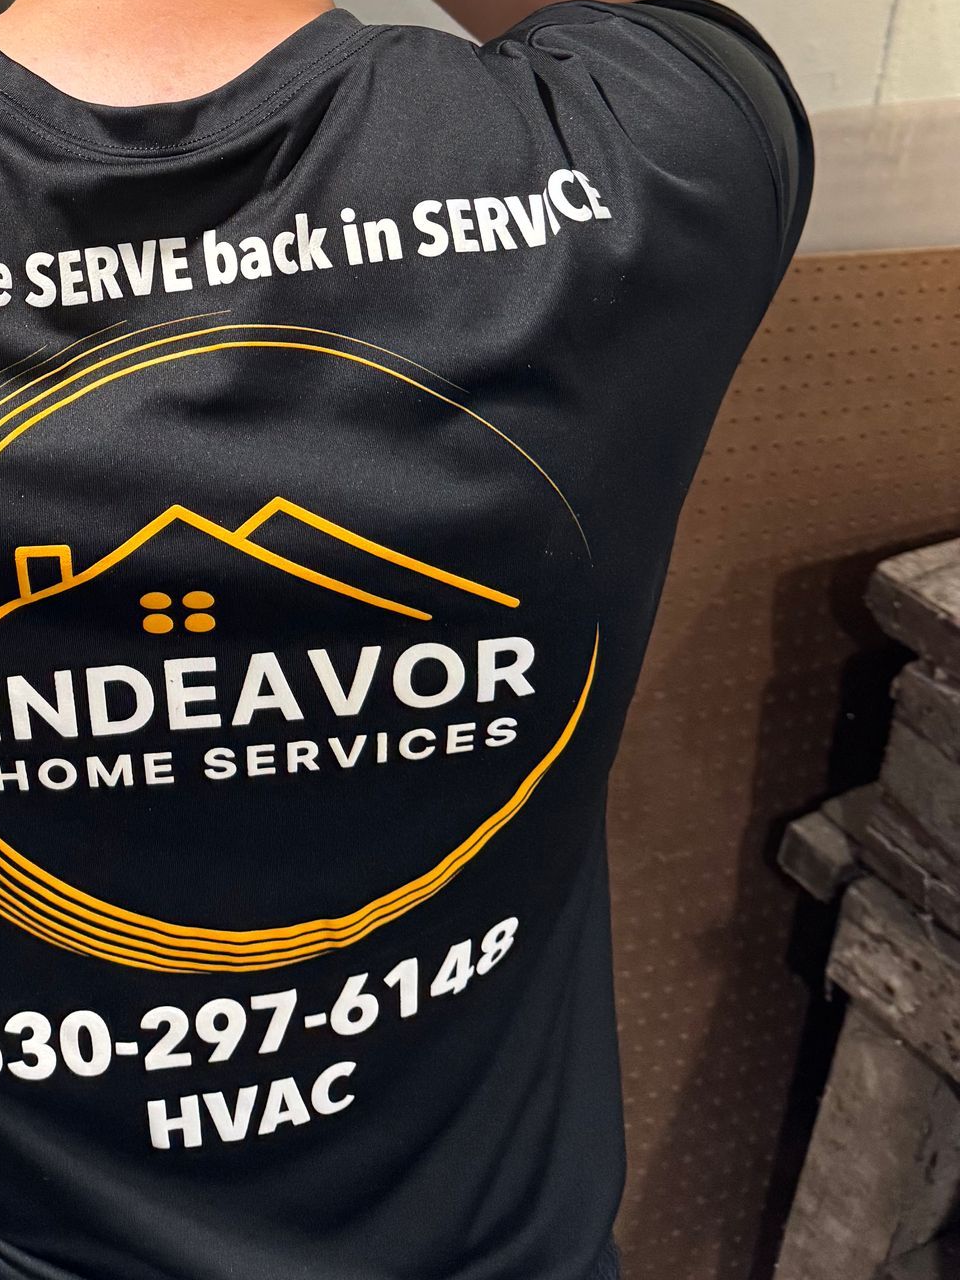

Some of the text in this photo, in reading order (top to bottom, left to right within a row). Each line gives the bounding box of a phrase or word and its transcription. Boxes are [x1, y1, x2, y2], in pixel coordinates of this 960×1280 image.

[24, 237, 194, 308] SERVE
[202, 213, 334, 287] back
[340, 207, 404, 266] in
[412, 168, 613, 258] SERVICE
[204, 717, 518, 780] SERVICES
[147, 1061, 357, 1149] HVAC
